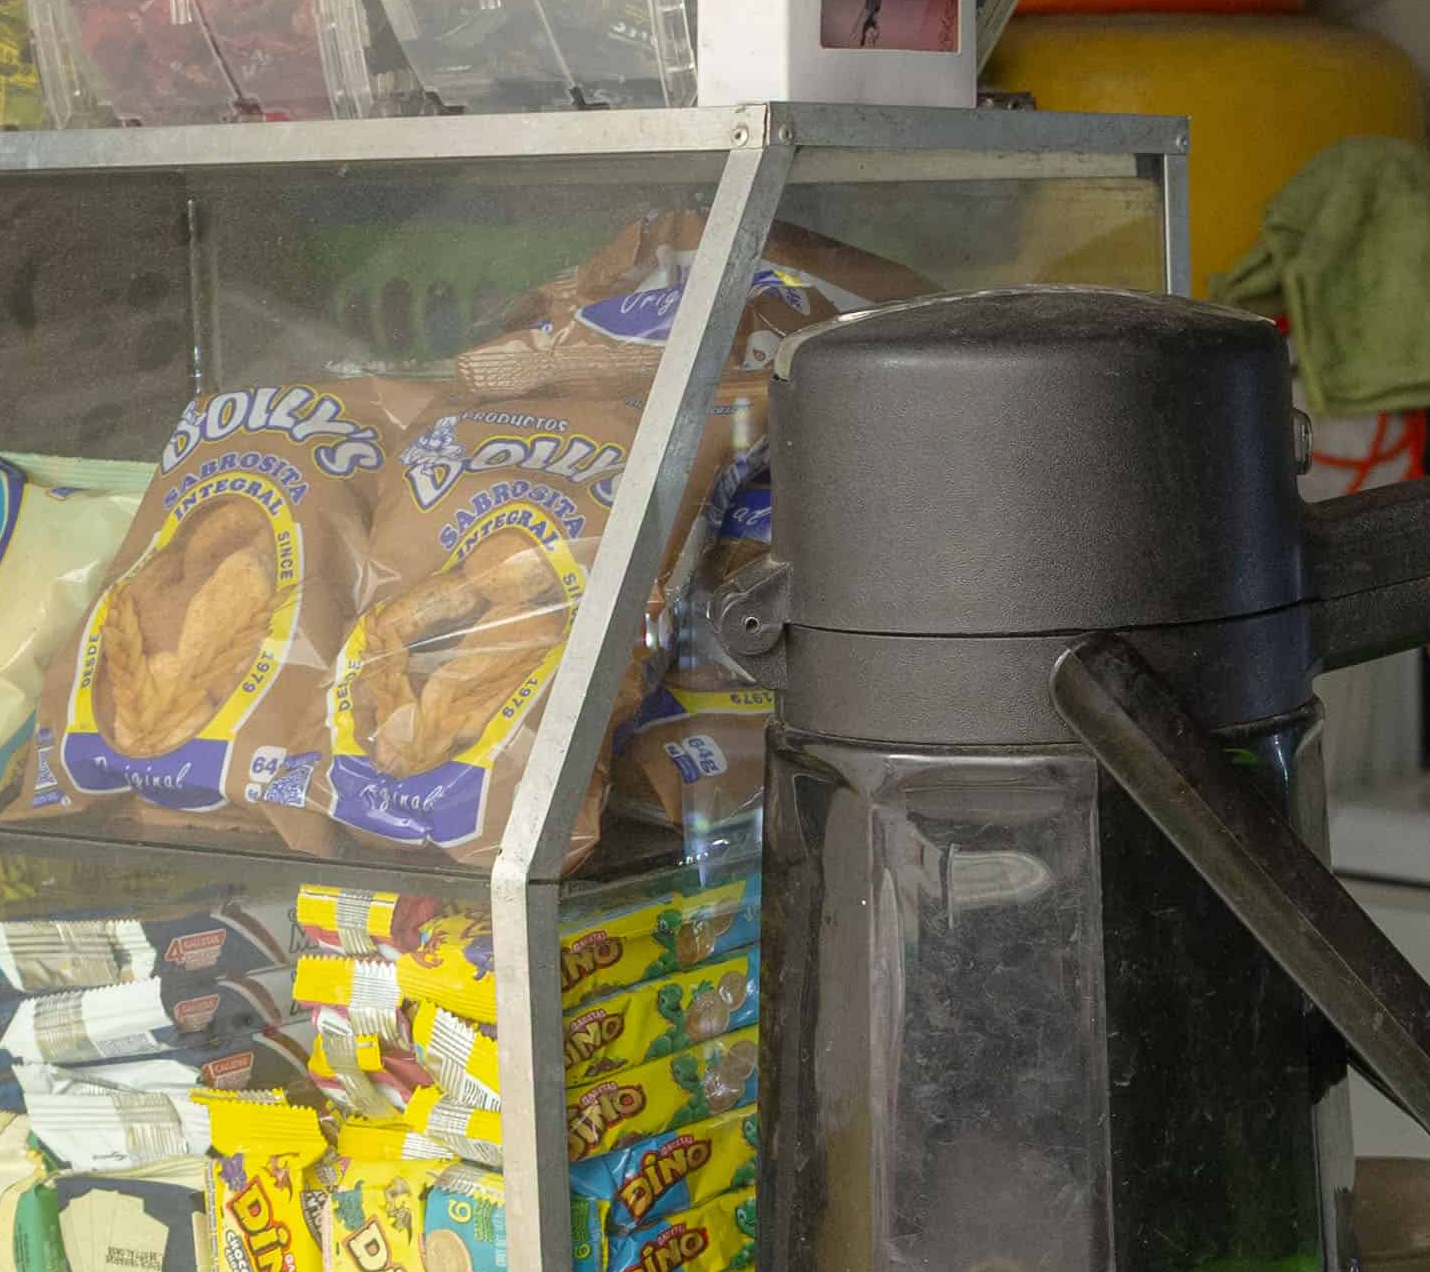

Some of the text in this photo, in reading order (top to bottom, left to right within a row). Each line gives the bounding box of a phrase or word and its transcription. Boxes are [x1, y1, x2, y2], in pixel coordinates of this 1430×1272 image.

[163, 451, 310, 509] SABROSITA
[173, 477, 284, 520] INTEGRAL
[438, 479, 586, 551] SABROSITA
[456, 508, 560, 560] INTEGRAL
[276, 530, 294, 581] SINCE
[242, 651, 276, 693] 1979
